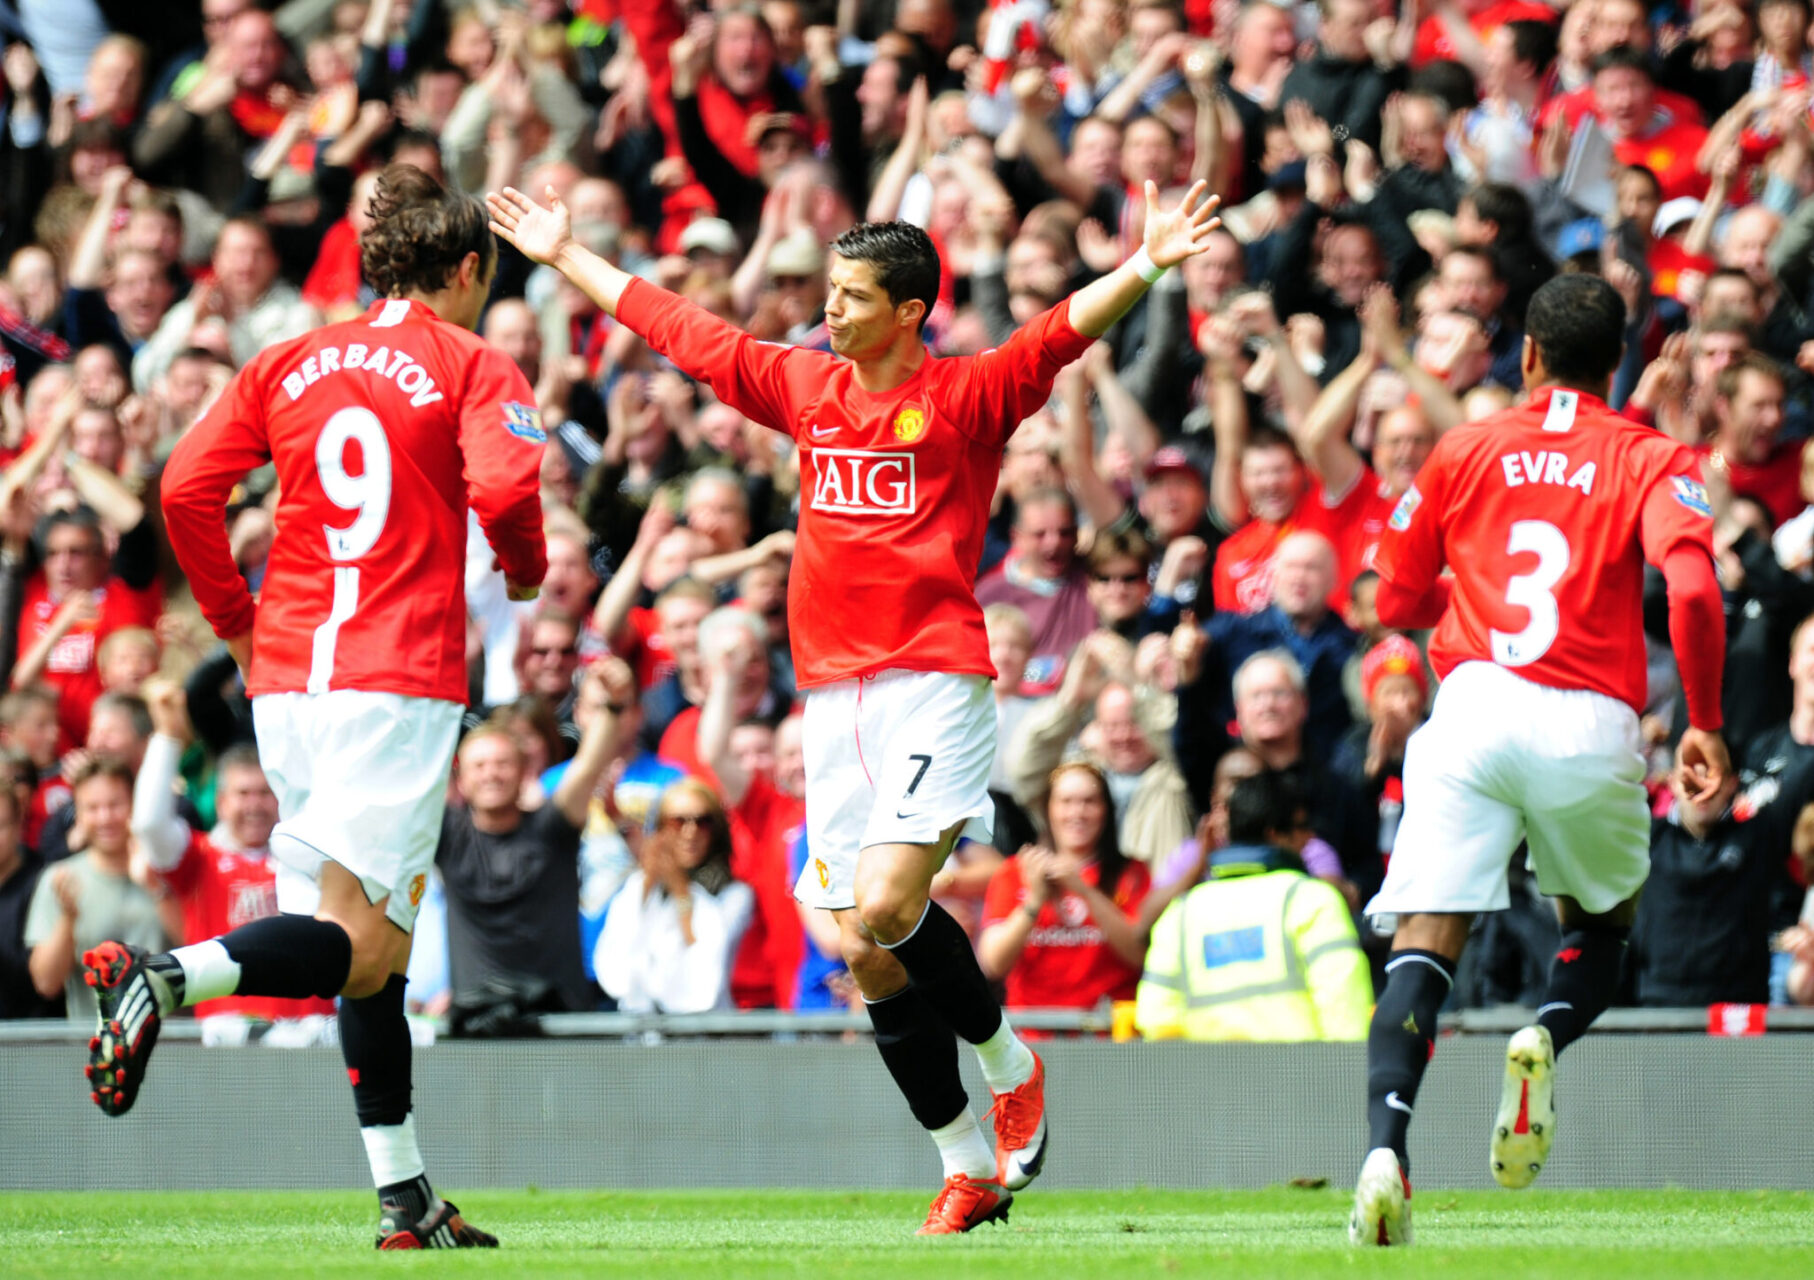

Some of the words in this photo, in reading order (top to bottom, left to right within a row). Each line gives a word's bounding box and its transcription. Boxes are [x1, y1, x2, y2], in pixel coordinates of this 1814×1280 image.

[281, 343, 444, 408] BERBATOV
[315, 406, 392, 561] 9
[819, 456, 908, 507] AIG
[1501, 450, 1597, 496] EVRA
[1489, 519, 1570, 667] 3
[903, 754, 933, 799] 7
